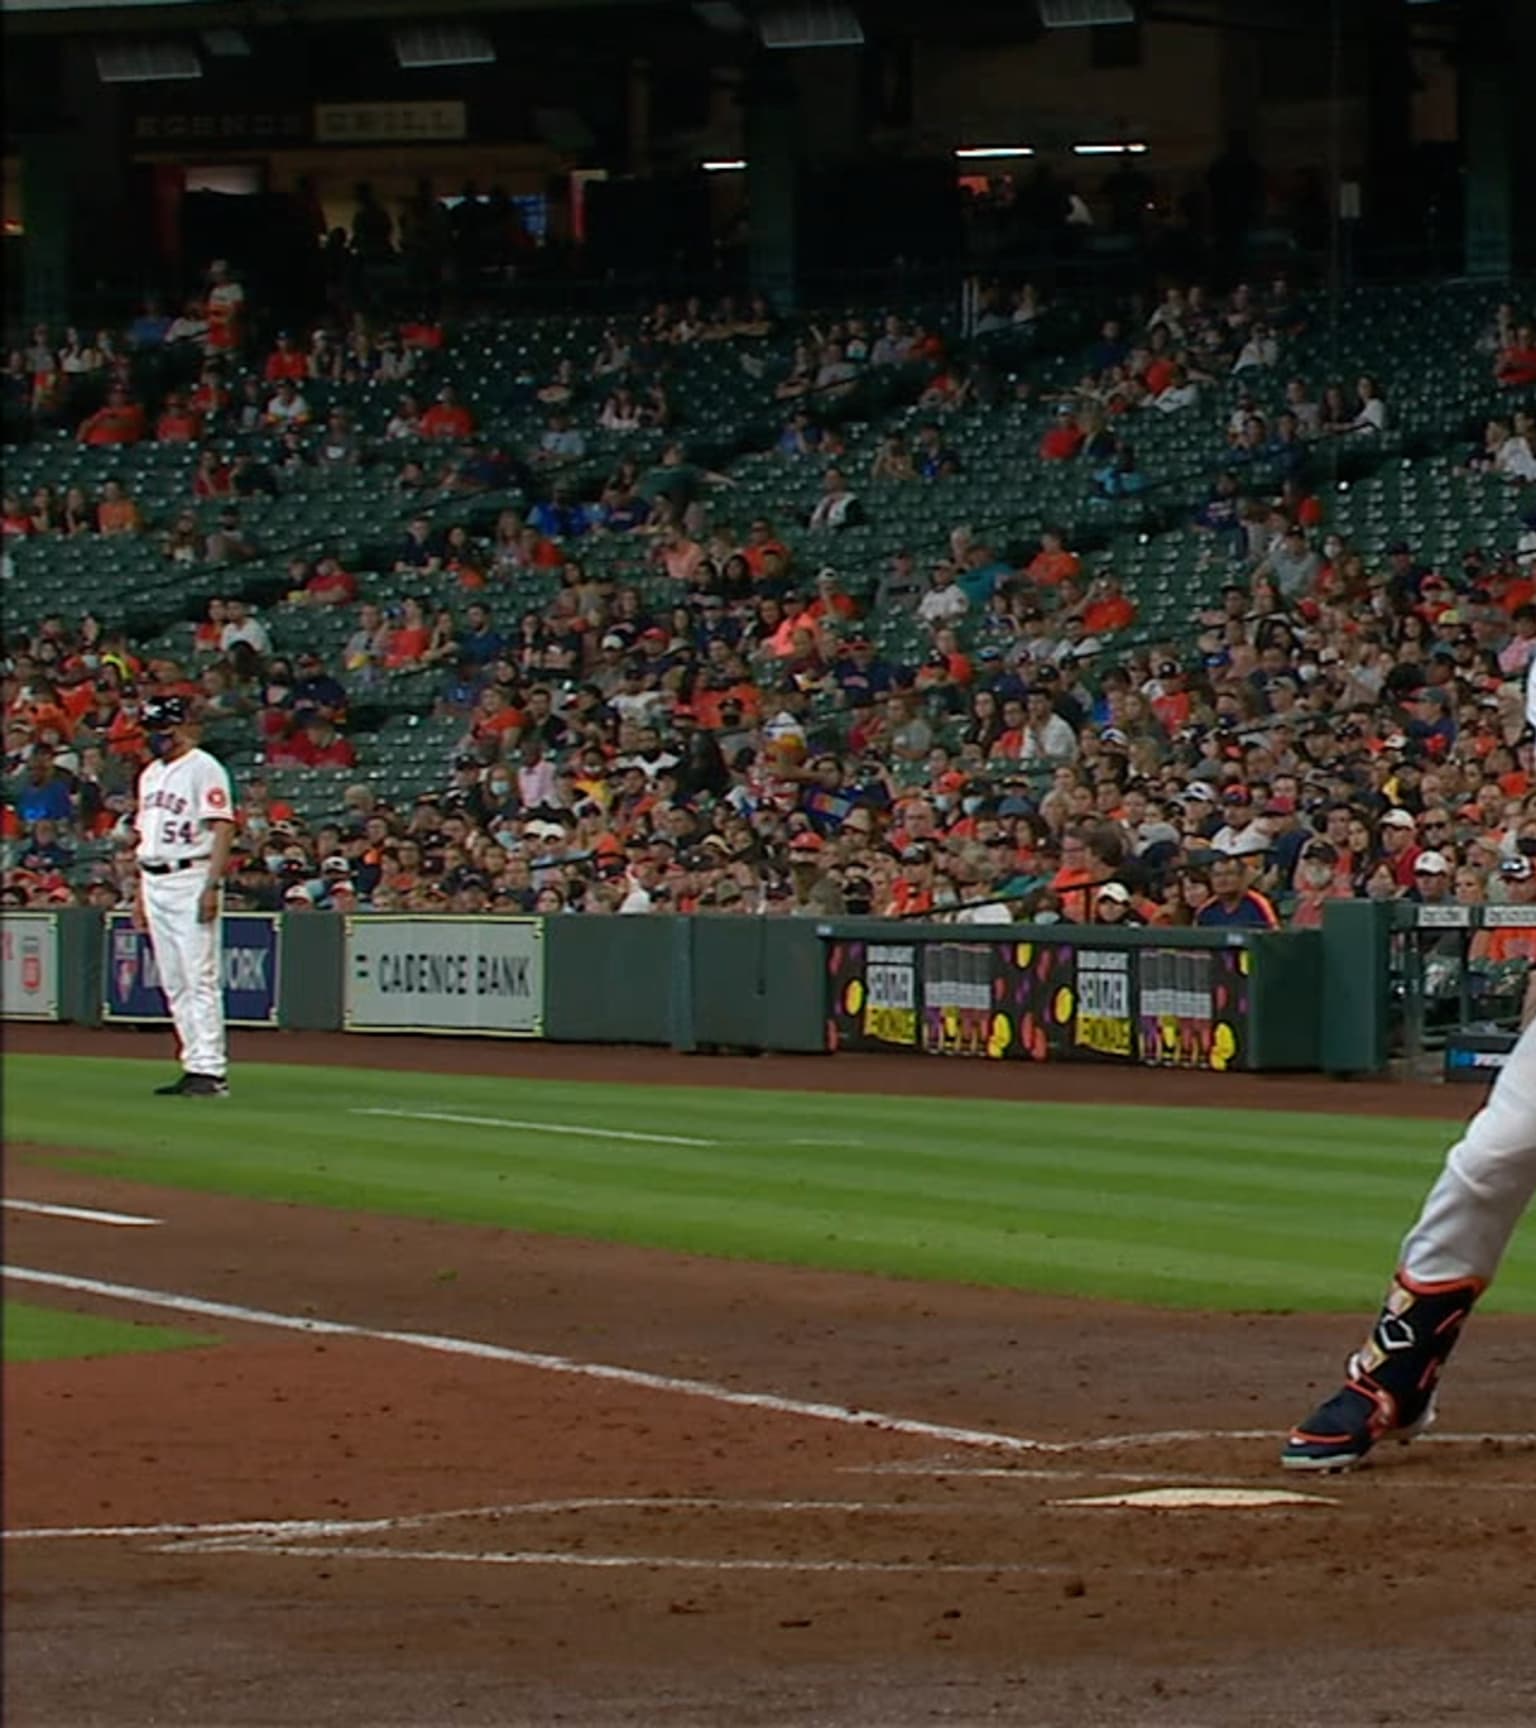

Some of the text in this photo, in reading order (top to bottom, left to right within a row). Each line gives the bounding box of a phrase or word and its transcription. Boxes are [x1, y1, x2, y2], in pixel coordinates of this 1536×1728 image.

[161, 820, 193, 845] 54
[378, 954, 531, 997] CADENCE BANK
